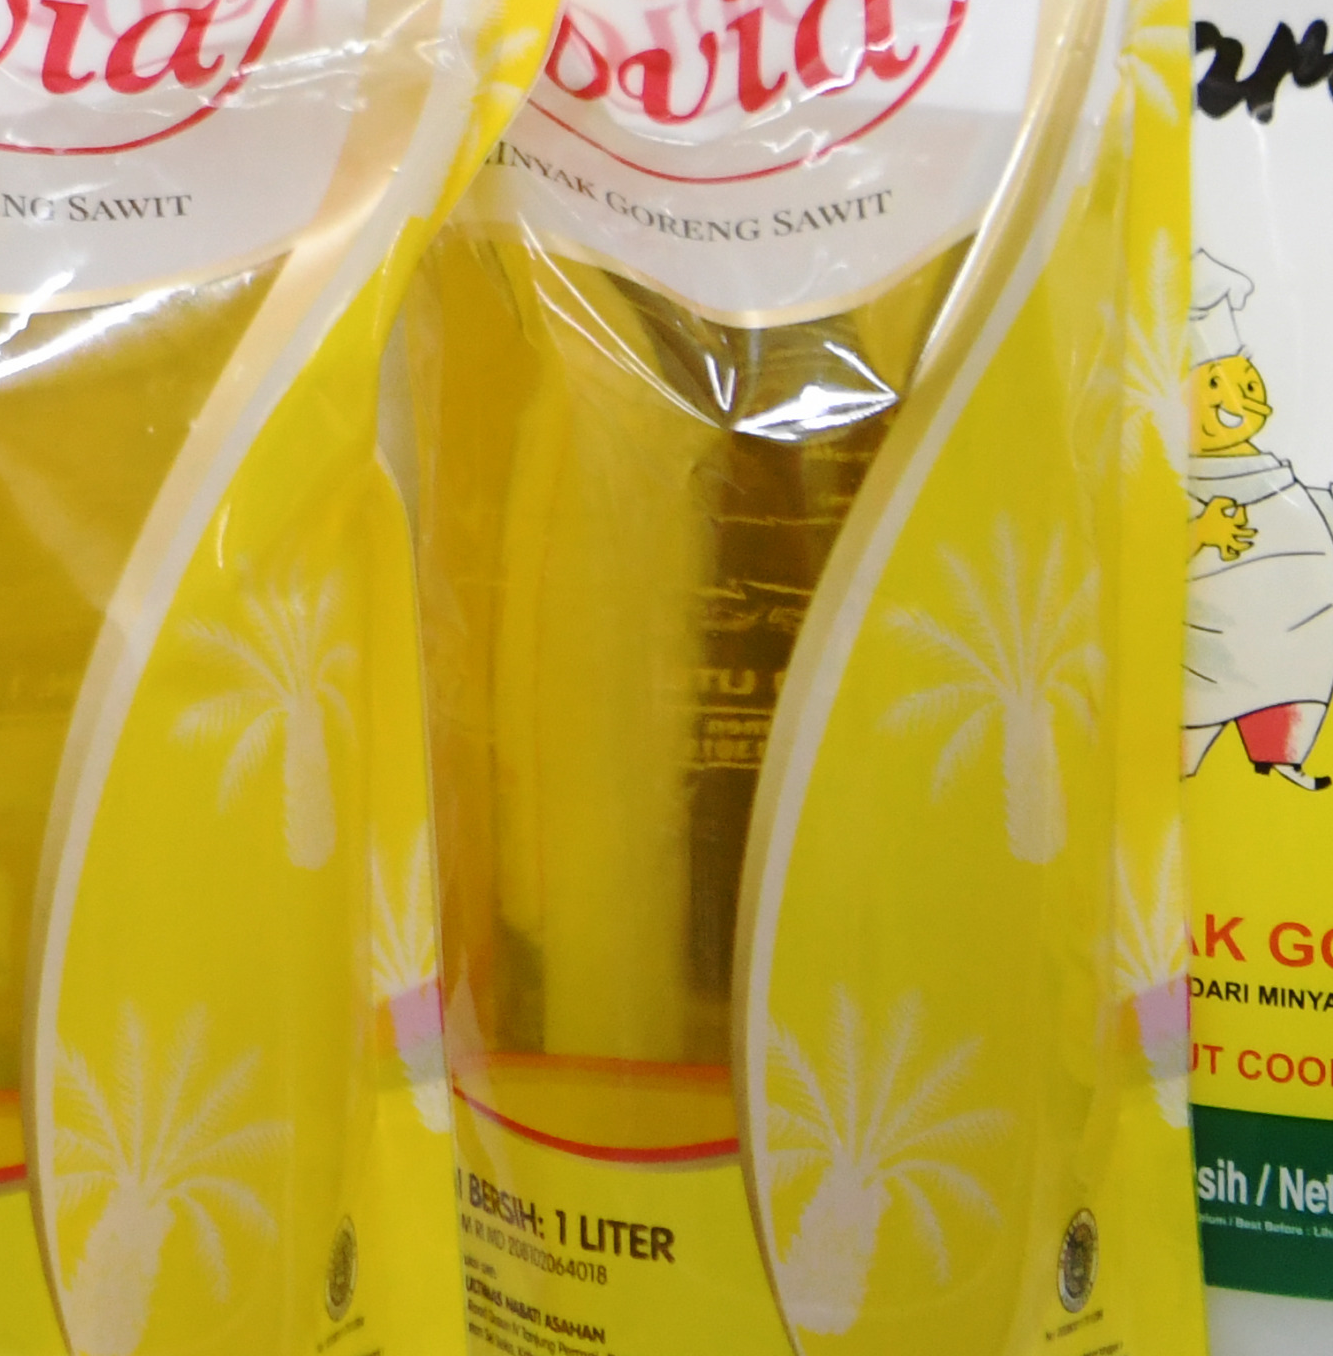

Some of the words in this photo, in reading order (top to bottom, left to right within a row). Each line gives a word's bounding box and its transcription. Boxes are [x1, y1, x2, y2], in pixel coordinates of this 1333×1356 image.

[67, 194, 193, 222] SAWIT
[486, 139, 598, 201] INYAK
[604, 189, 761, 244] GORENG
[772, 189, 893, 238] SAWIT
[1190, 976, 1249, 1004] DARI
[1237, 1048, 1333, 1088] COO
[469, 1172, 546, 1241] BERSIH:
[555, 1208, 567, 1246] 1
[579, 1214, 676, 1264] LITER
